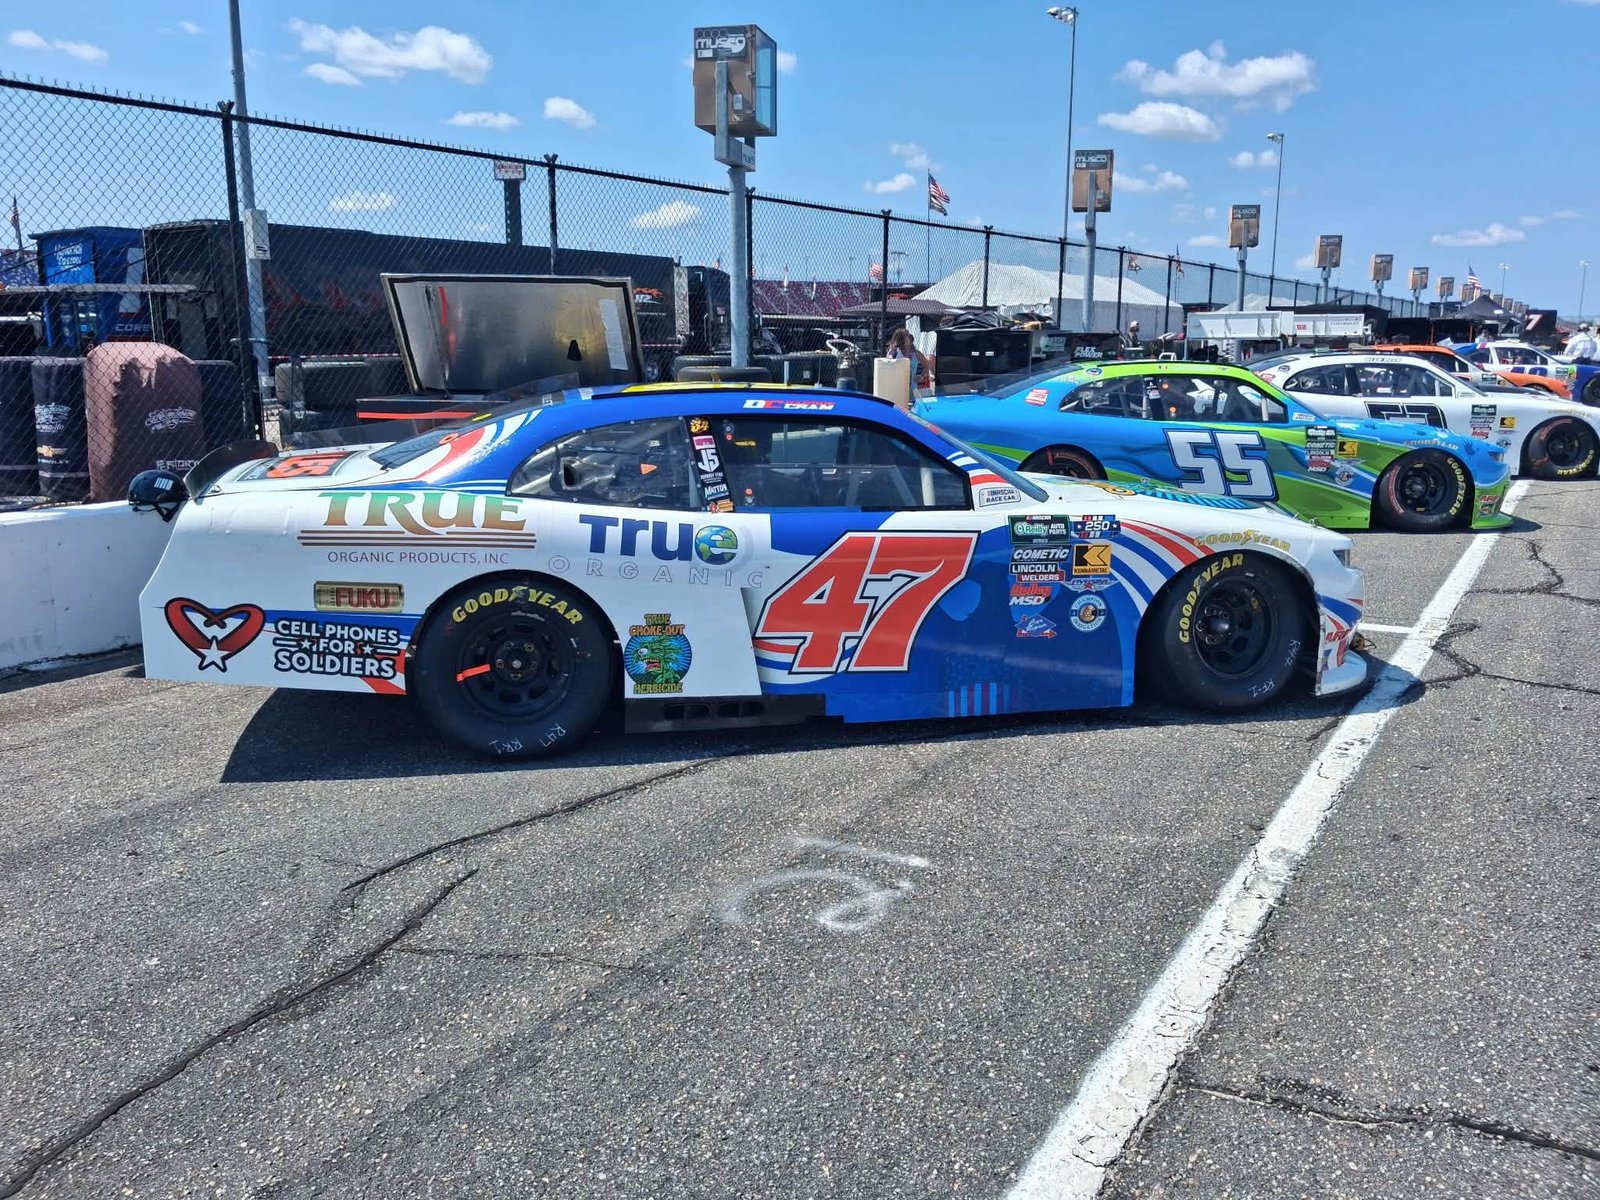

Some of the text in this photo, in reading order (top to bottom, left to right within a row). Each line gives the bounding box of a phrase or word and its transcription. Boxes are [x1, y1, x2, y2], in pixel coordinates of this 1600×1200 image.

[784, 403, 835, 411] CRAM
[1165, 429, 1277, 500] 55
[1446, 457, 1467, 516] GOODYEAR
[318, 492, 527, 535] TRUE
[1084, 521, 1110, 531] 250
[579, 514, 738, 565] True
[1194, 529, 1292, 551] GOODYEAR
[327, 551, 509, 566] ORGANIC PRODUCTS, INC
[1013, 548, 1070, 560] COMETIC
[548, 554, 763, 589] ORGANIC
[1012, 564, 1056, 573] LINCOLN
[336, 587, 390, 608] FUKU
[453, 586, 584, 625] GOODYEAR
[754, 530, 981, 674] 47
[1008, 596, 1047, 606] MSD
[1179, 553, 1244, 644] GOODYEAR
[644, 613, 672, 625] TRUE
[277, 619, 399, 644] CELL PHONES
[319, 638, 355, 654] FOR
[275, 653, 395, 677] SOLDIERS
[633, 682, 684, 694] HERBICIDE
